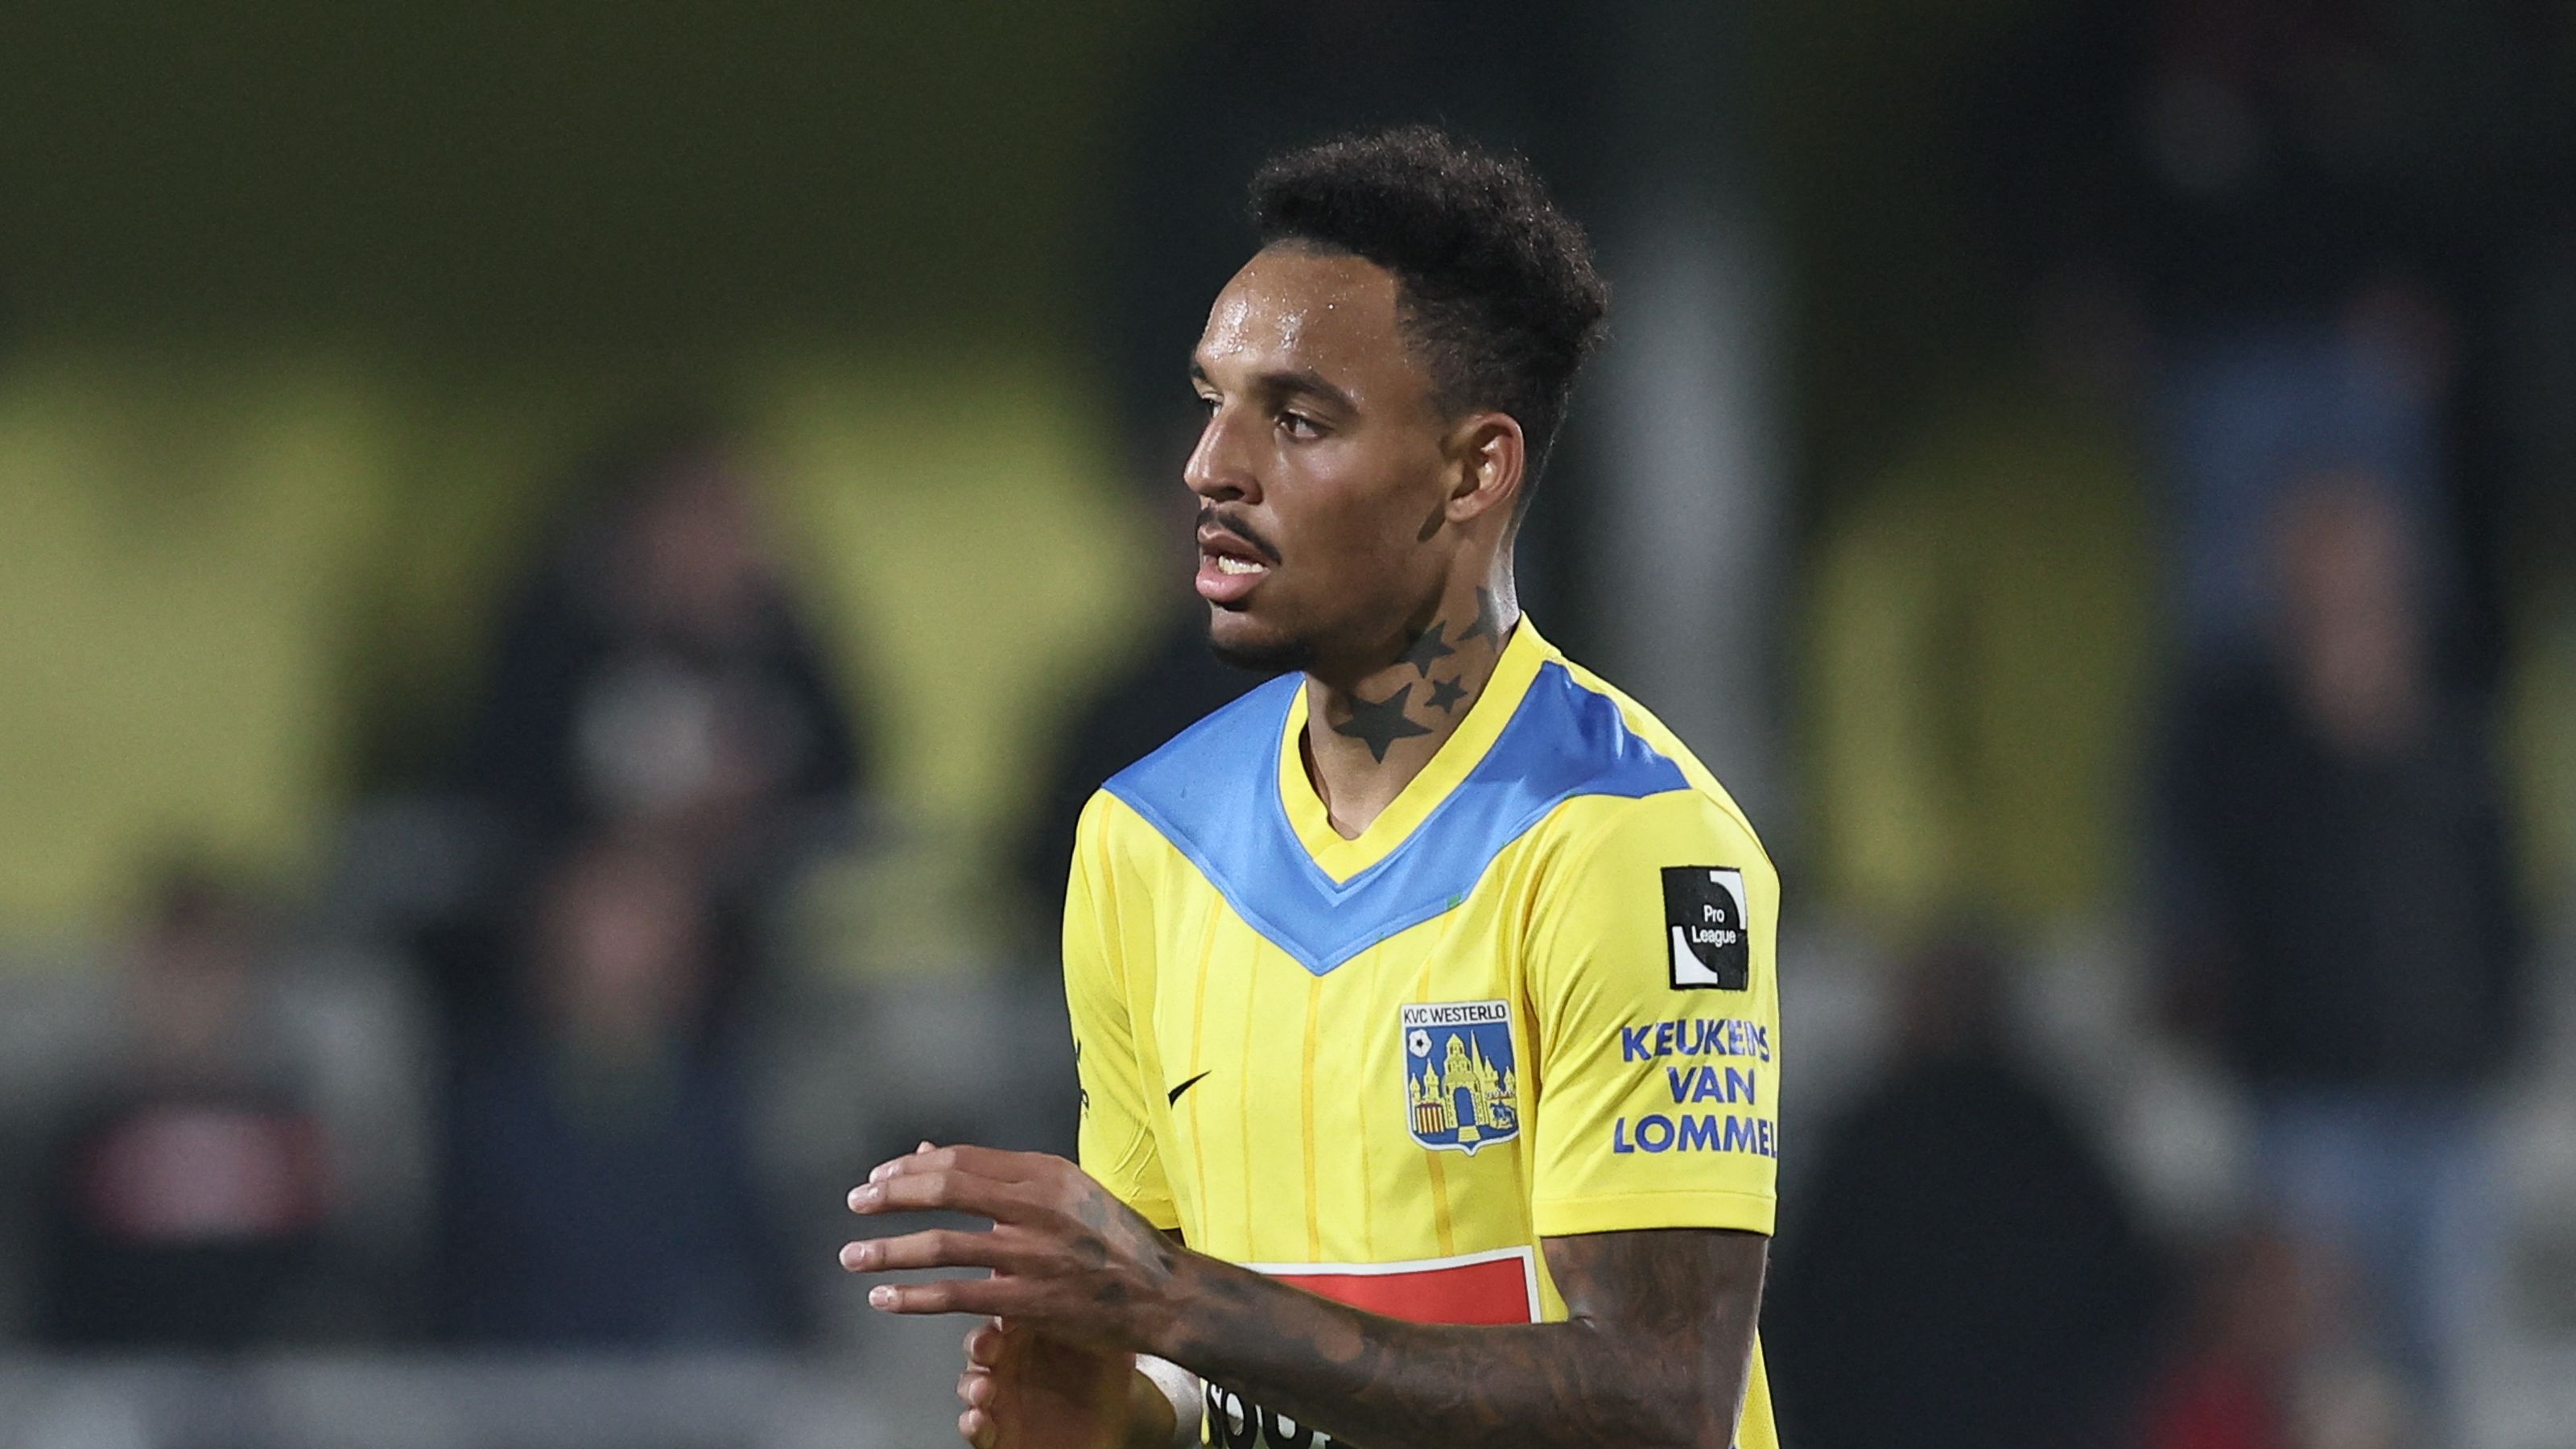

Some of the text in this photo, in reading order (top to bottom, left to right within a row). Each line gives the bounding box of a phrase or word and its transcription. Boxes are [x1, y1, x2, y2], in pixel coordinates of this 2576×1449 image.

[1703, 905, 1725, 923] Pro
[1691, 926, 1736, 947] League
[1404, 1004, 1506, 1023] KVC WESTERLO
[1622, 1018, 1770, 1063] KEUKENS
[1667, 1065, 1755, 1105] VAN
[1613, 1114, 1777, 1159] LOMMEL
